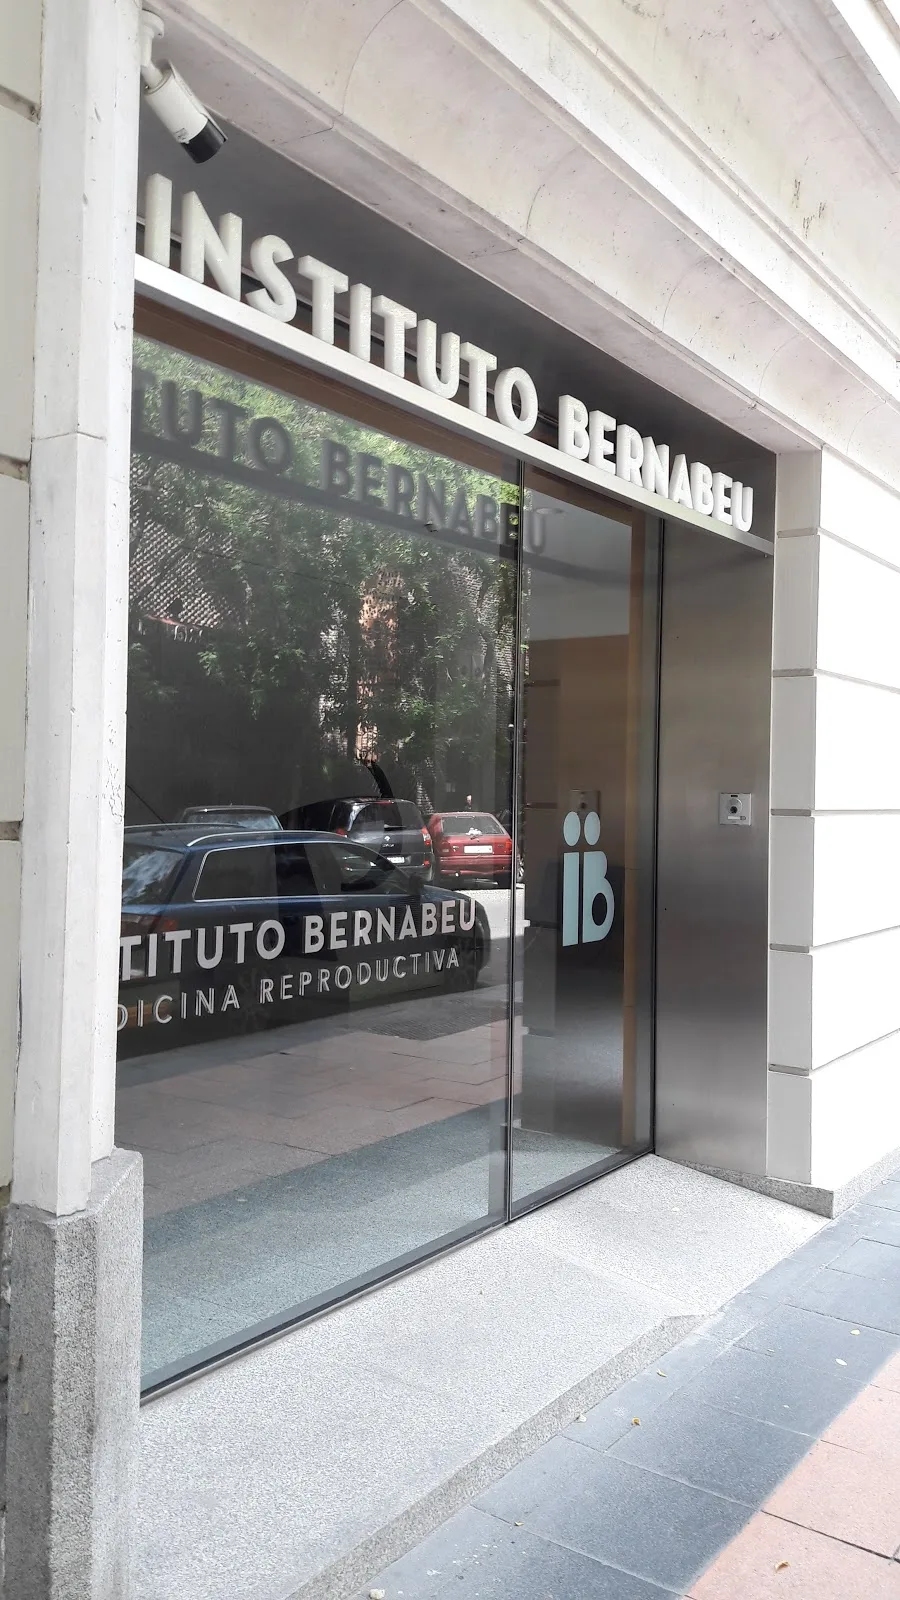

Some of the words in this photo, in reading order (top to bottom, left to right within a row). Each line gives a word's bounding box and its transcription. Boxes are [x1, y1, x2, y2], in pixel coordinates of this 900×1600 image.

[143, 172, 538, 435] INSTITUTO
[558, 394, 753, 532] BERNABEU
[119, 919, 286, 982] TITUTO
[303, 899, 476, 954] BERNABEU
[259, 947, 460, 1004] REPRODUCTIVA
